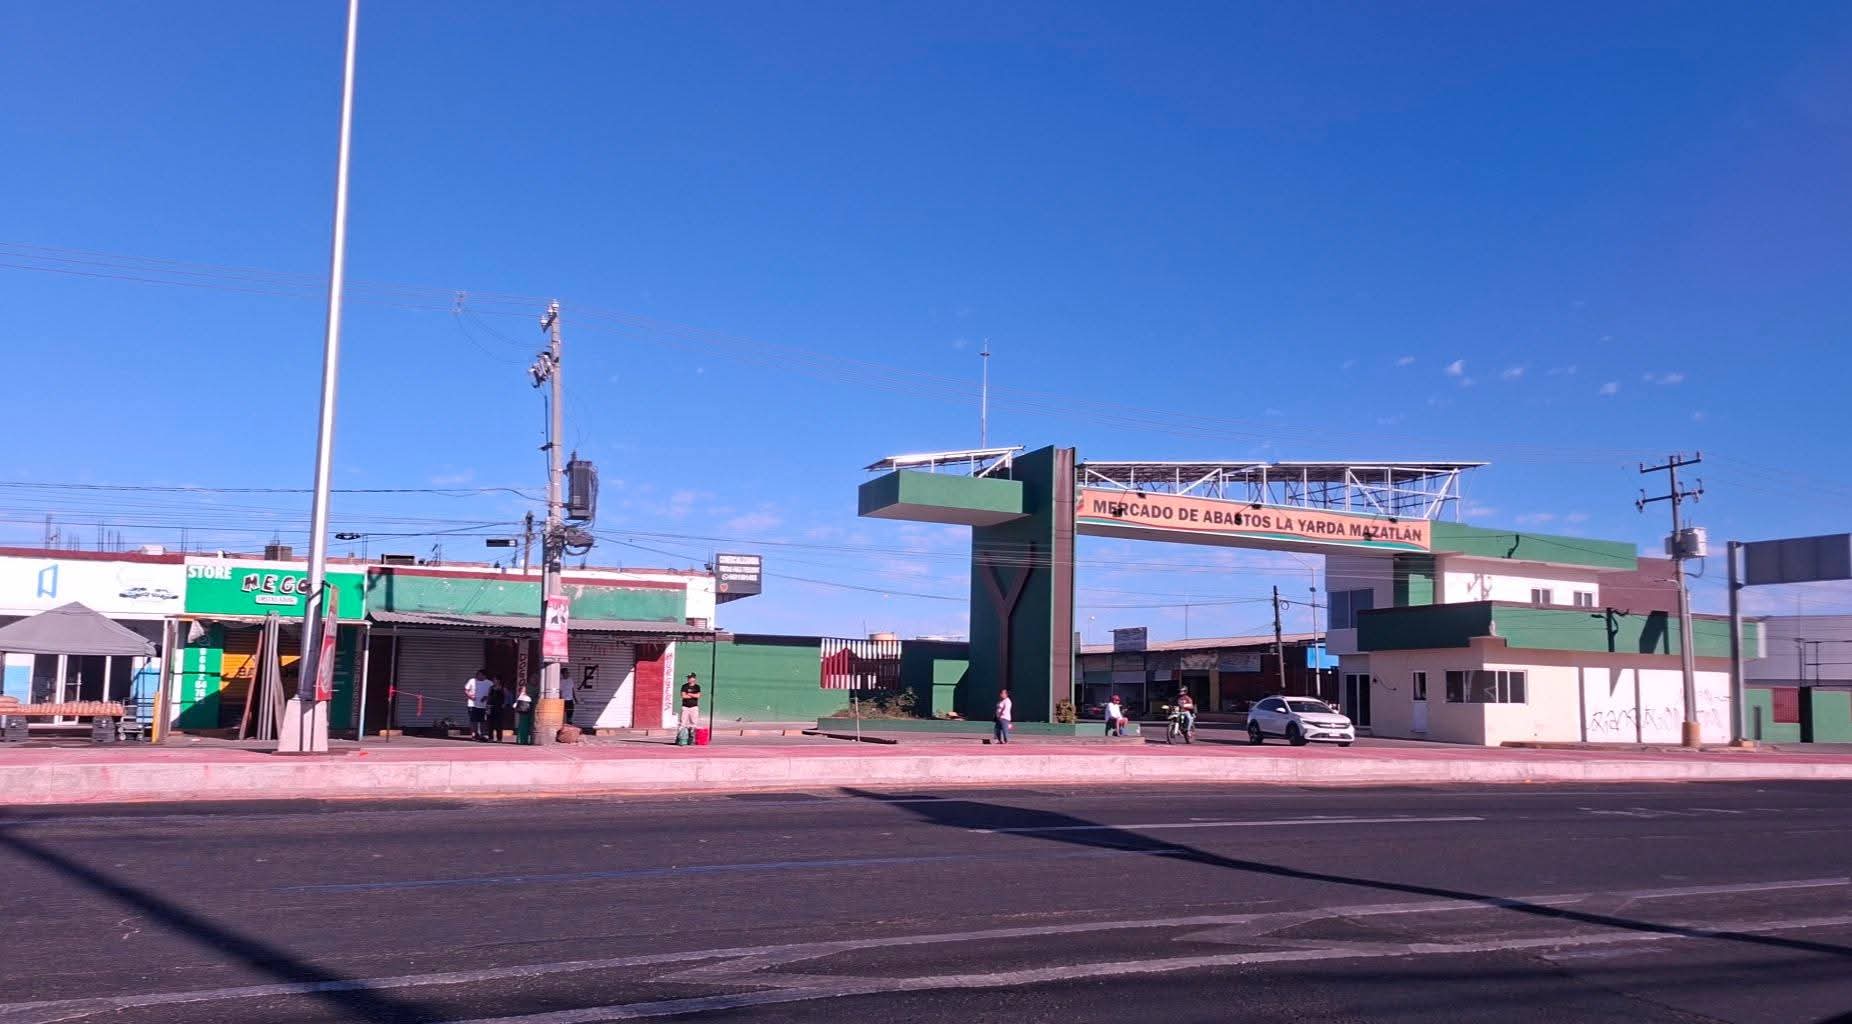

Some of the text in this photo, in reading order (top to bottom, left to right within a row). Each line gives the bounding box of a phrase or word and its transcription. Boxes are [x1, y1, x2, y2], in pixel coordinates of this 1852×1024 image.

[1093, 499, 1174, 519] MERCADO
[1178, 507, 1199, 522] DE
[1276, 516, 1294, 531] LA
[1299, 518, 1346, 536] YARDA
[1350, 523, 1422, 542] MAZATLÁN
[187, 564, 233, 579] STORE
